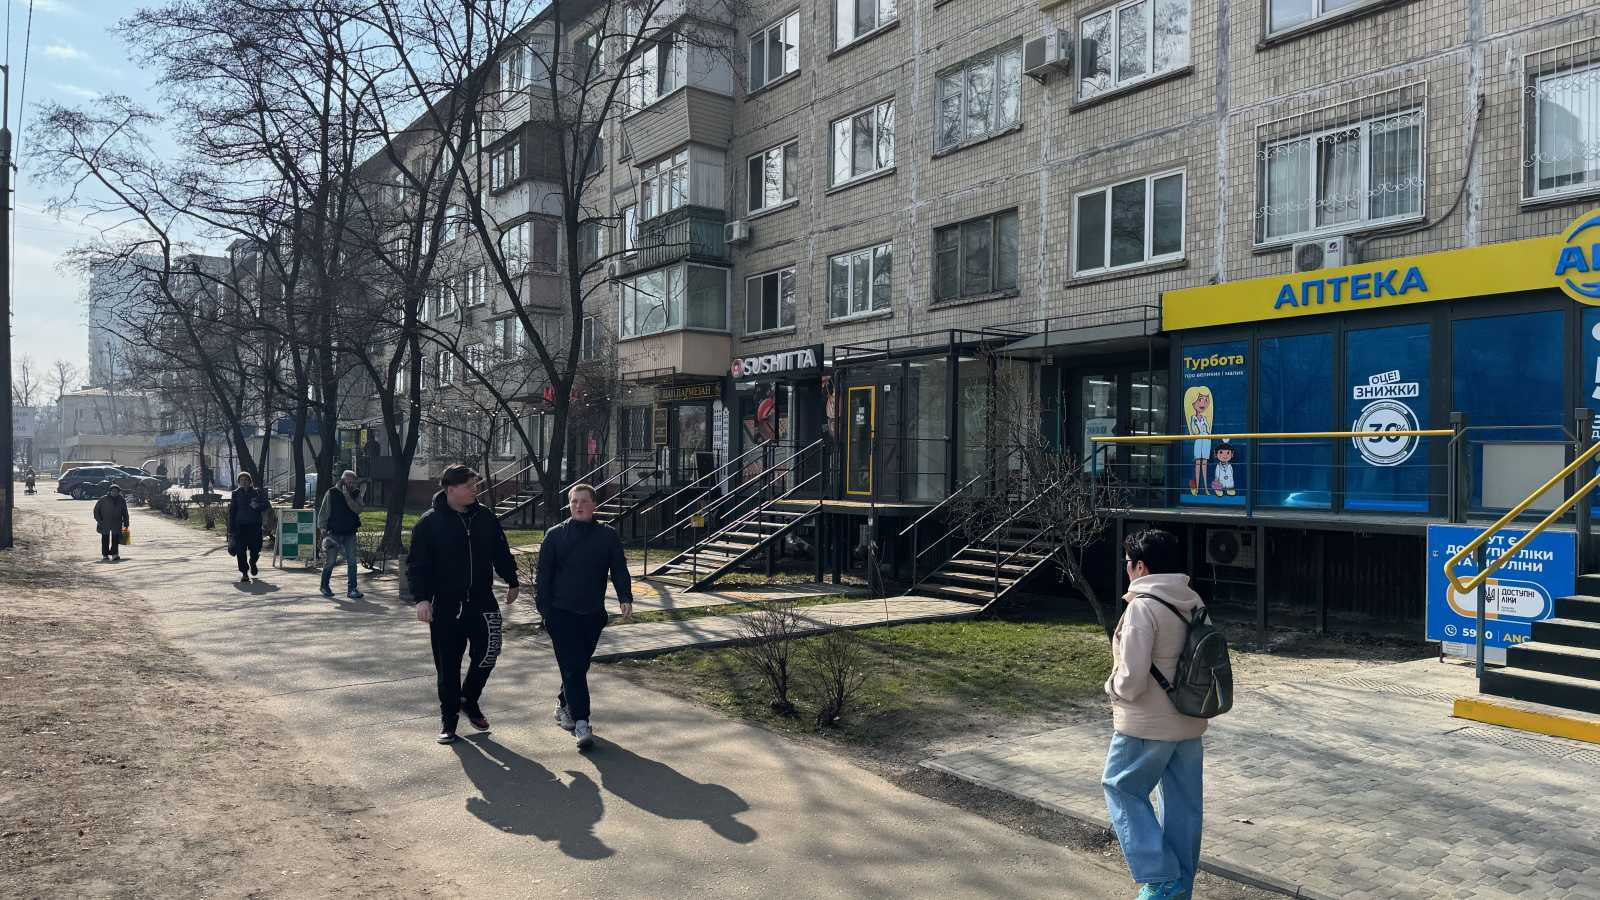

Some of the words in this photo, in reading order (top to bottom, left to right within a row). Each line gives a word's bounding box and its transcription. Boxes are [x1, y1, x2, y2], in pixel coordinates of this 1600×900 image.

[1274, 266, 1428, 309] АПТЕКА
[743, 349, 817, 376] SUSHITTA
[1184, 354, 1244, 370] Турбота
[1371, 371, 1398, 385] ОЦЕ!
[1356, 384, 1417, 398] ЗНИЖКИ
[1446, 545, 1515, 559] ДОПН
[1519, 549, 1553, 560] ЛІКИ
[1477, 559, 1542, 572] УЛІНИ
[1501, 588, 1535, 598] ДОСТУПНІ
[1463, 628, 1493, 640] 590
